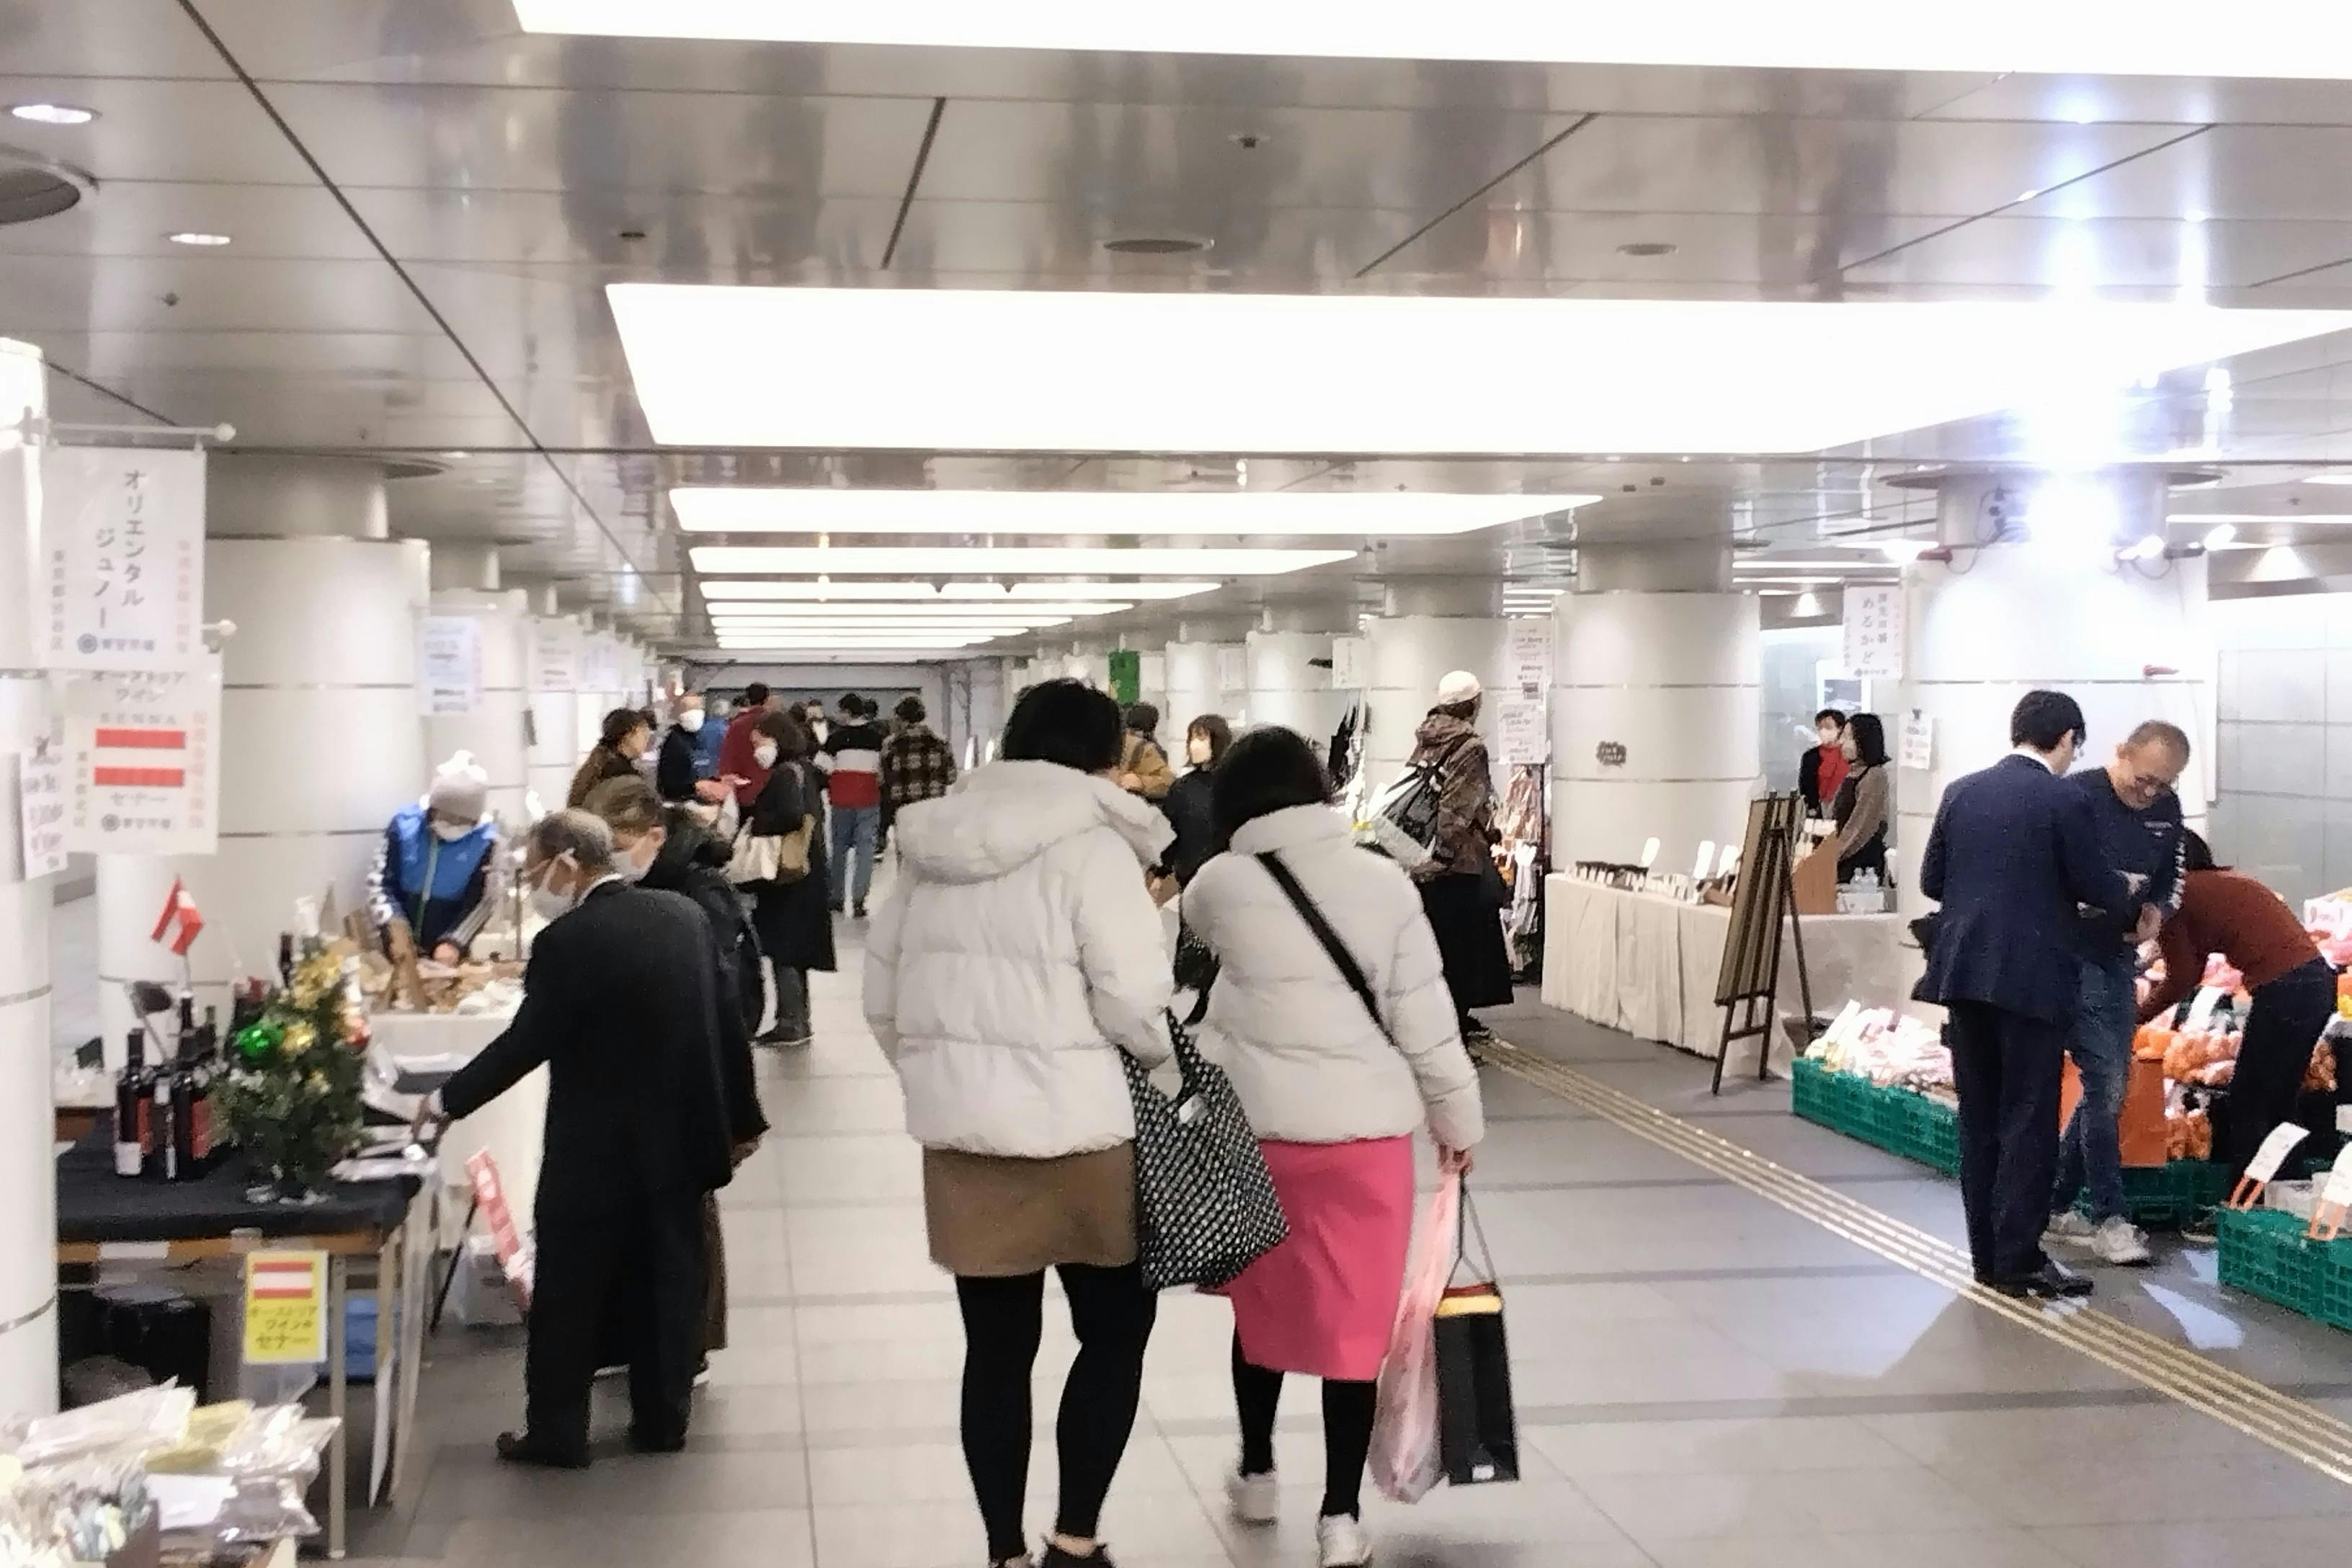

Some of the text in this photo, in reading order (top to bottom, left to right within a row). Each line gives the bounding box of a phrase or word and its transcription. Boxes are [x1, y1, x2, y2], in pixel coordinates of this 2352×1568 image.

[94, 528, 115, 629] ジュノー
[124, 470, 146, 607] オリエンタル
